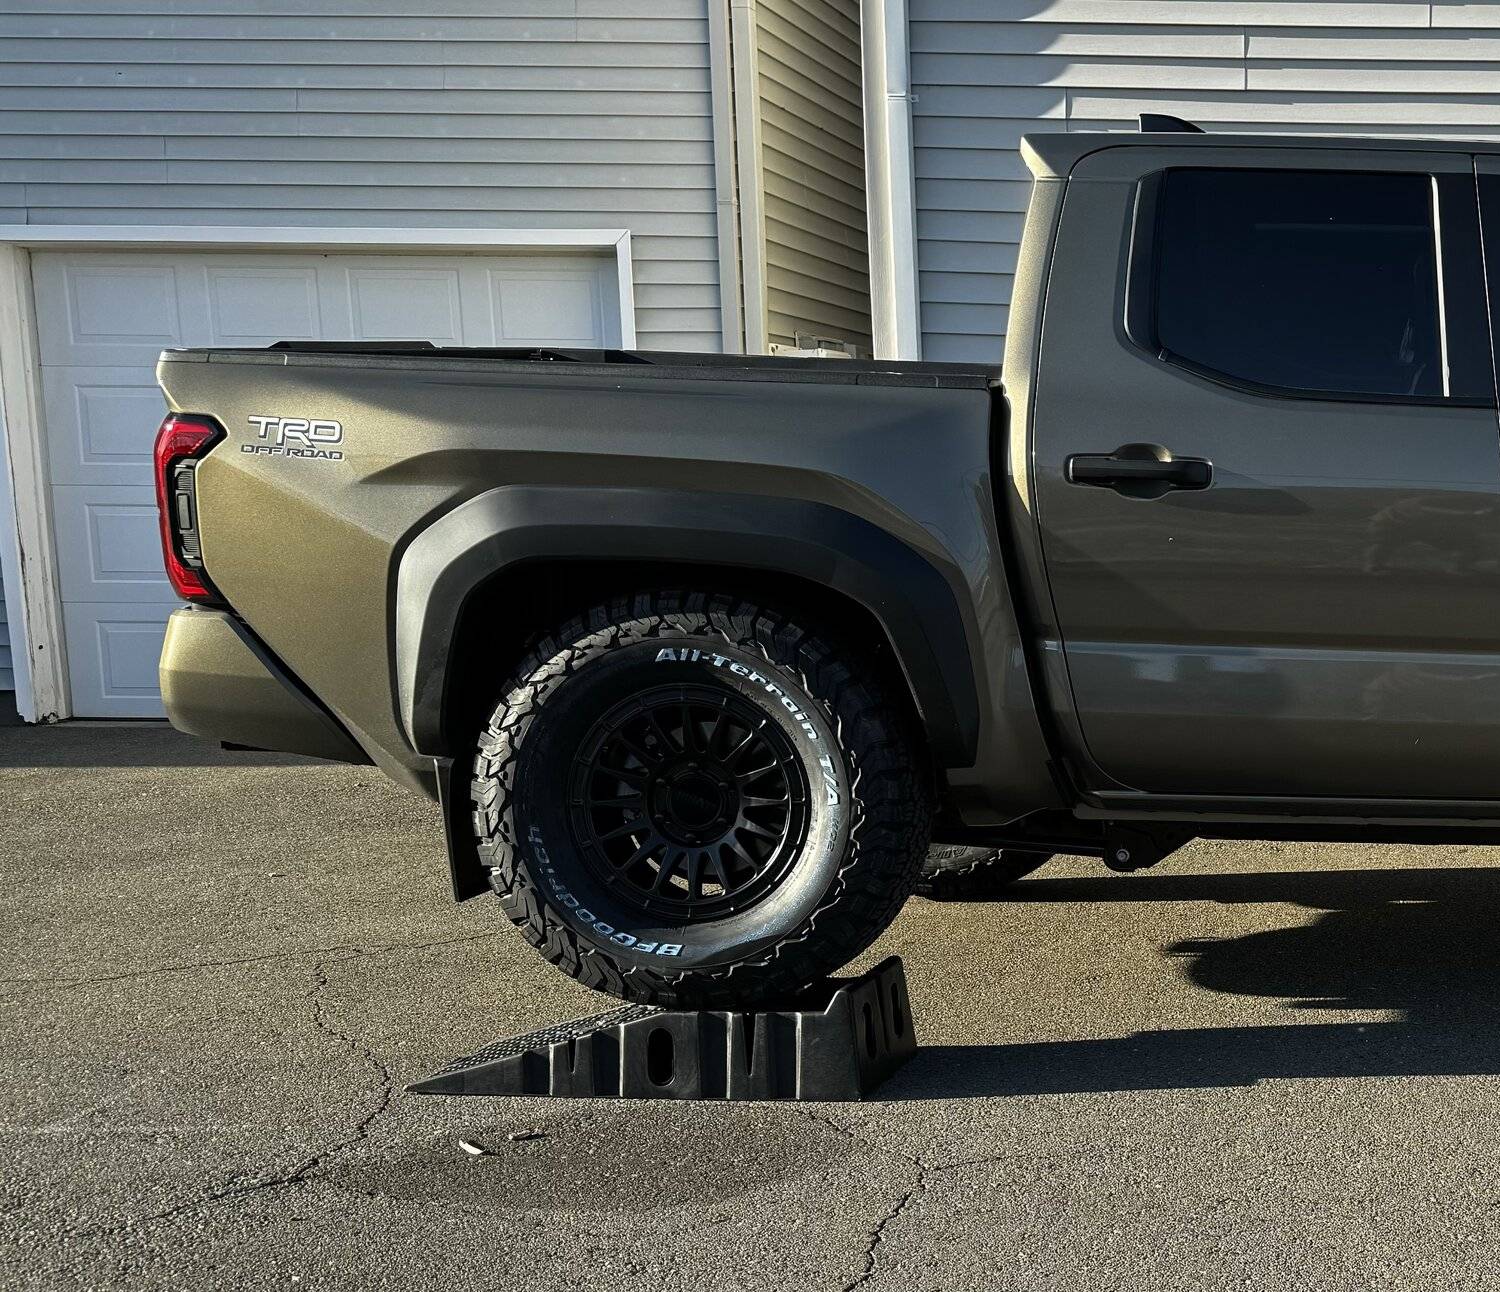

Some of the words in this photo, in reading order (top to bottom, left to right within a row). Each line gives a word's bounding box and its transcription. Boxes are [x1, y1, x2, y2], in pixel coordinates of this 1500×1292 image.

[240, 444, 284, 455] OFF
[286, 447, 344, 460] ROAD
[248, 414, 344, 448] TRD
[654, 646, 820, 742] All-Terrain
[817, 753, 841, 808] T/A
[526, 823, 687, 958] BFGoodrich
